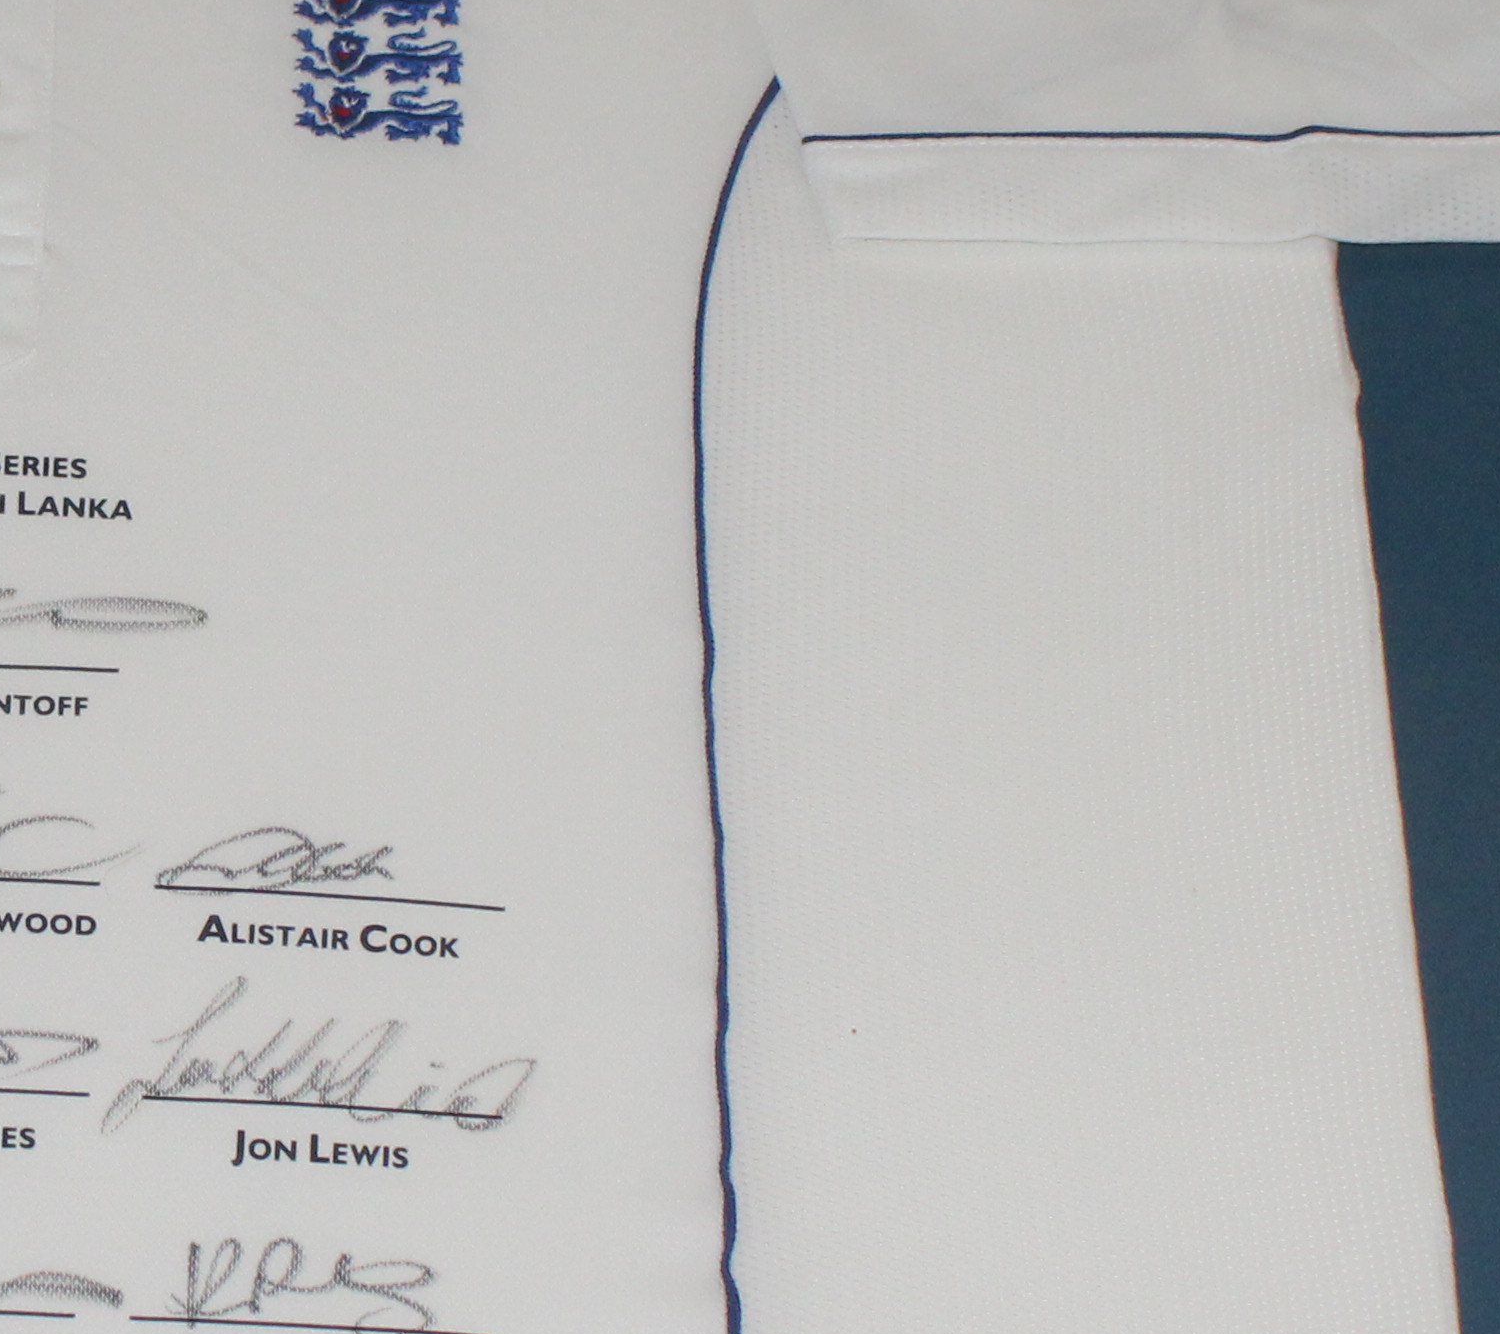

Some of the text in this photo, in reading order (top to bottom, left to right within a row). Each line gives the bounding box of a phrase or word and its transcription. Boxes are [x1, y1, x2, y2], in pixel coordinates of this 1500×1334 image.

[18, 491, 132, 520] LANKA
[198, 914, 458, 958] ALISTAIR COOK
[232, 1130, 408, 1169] JON LEWIS
